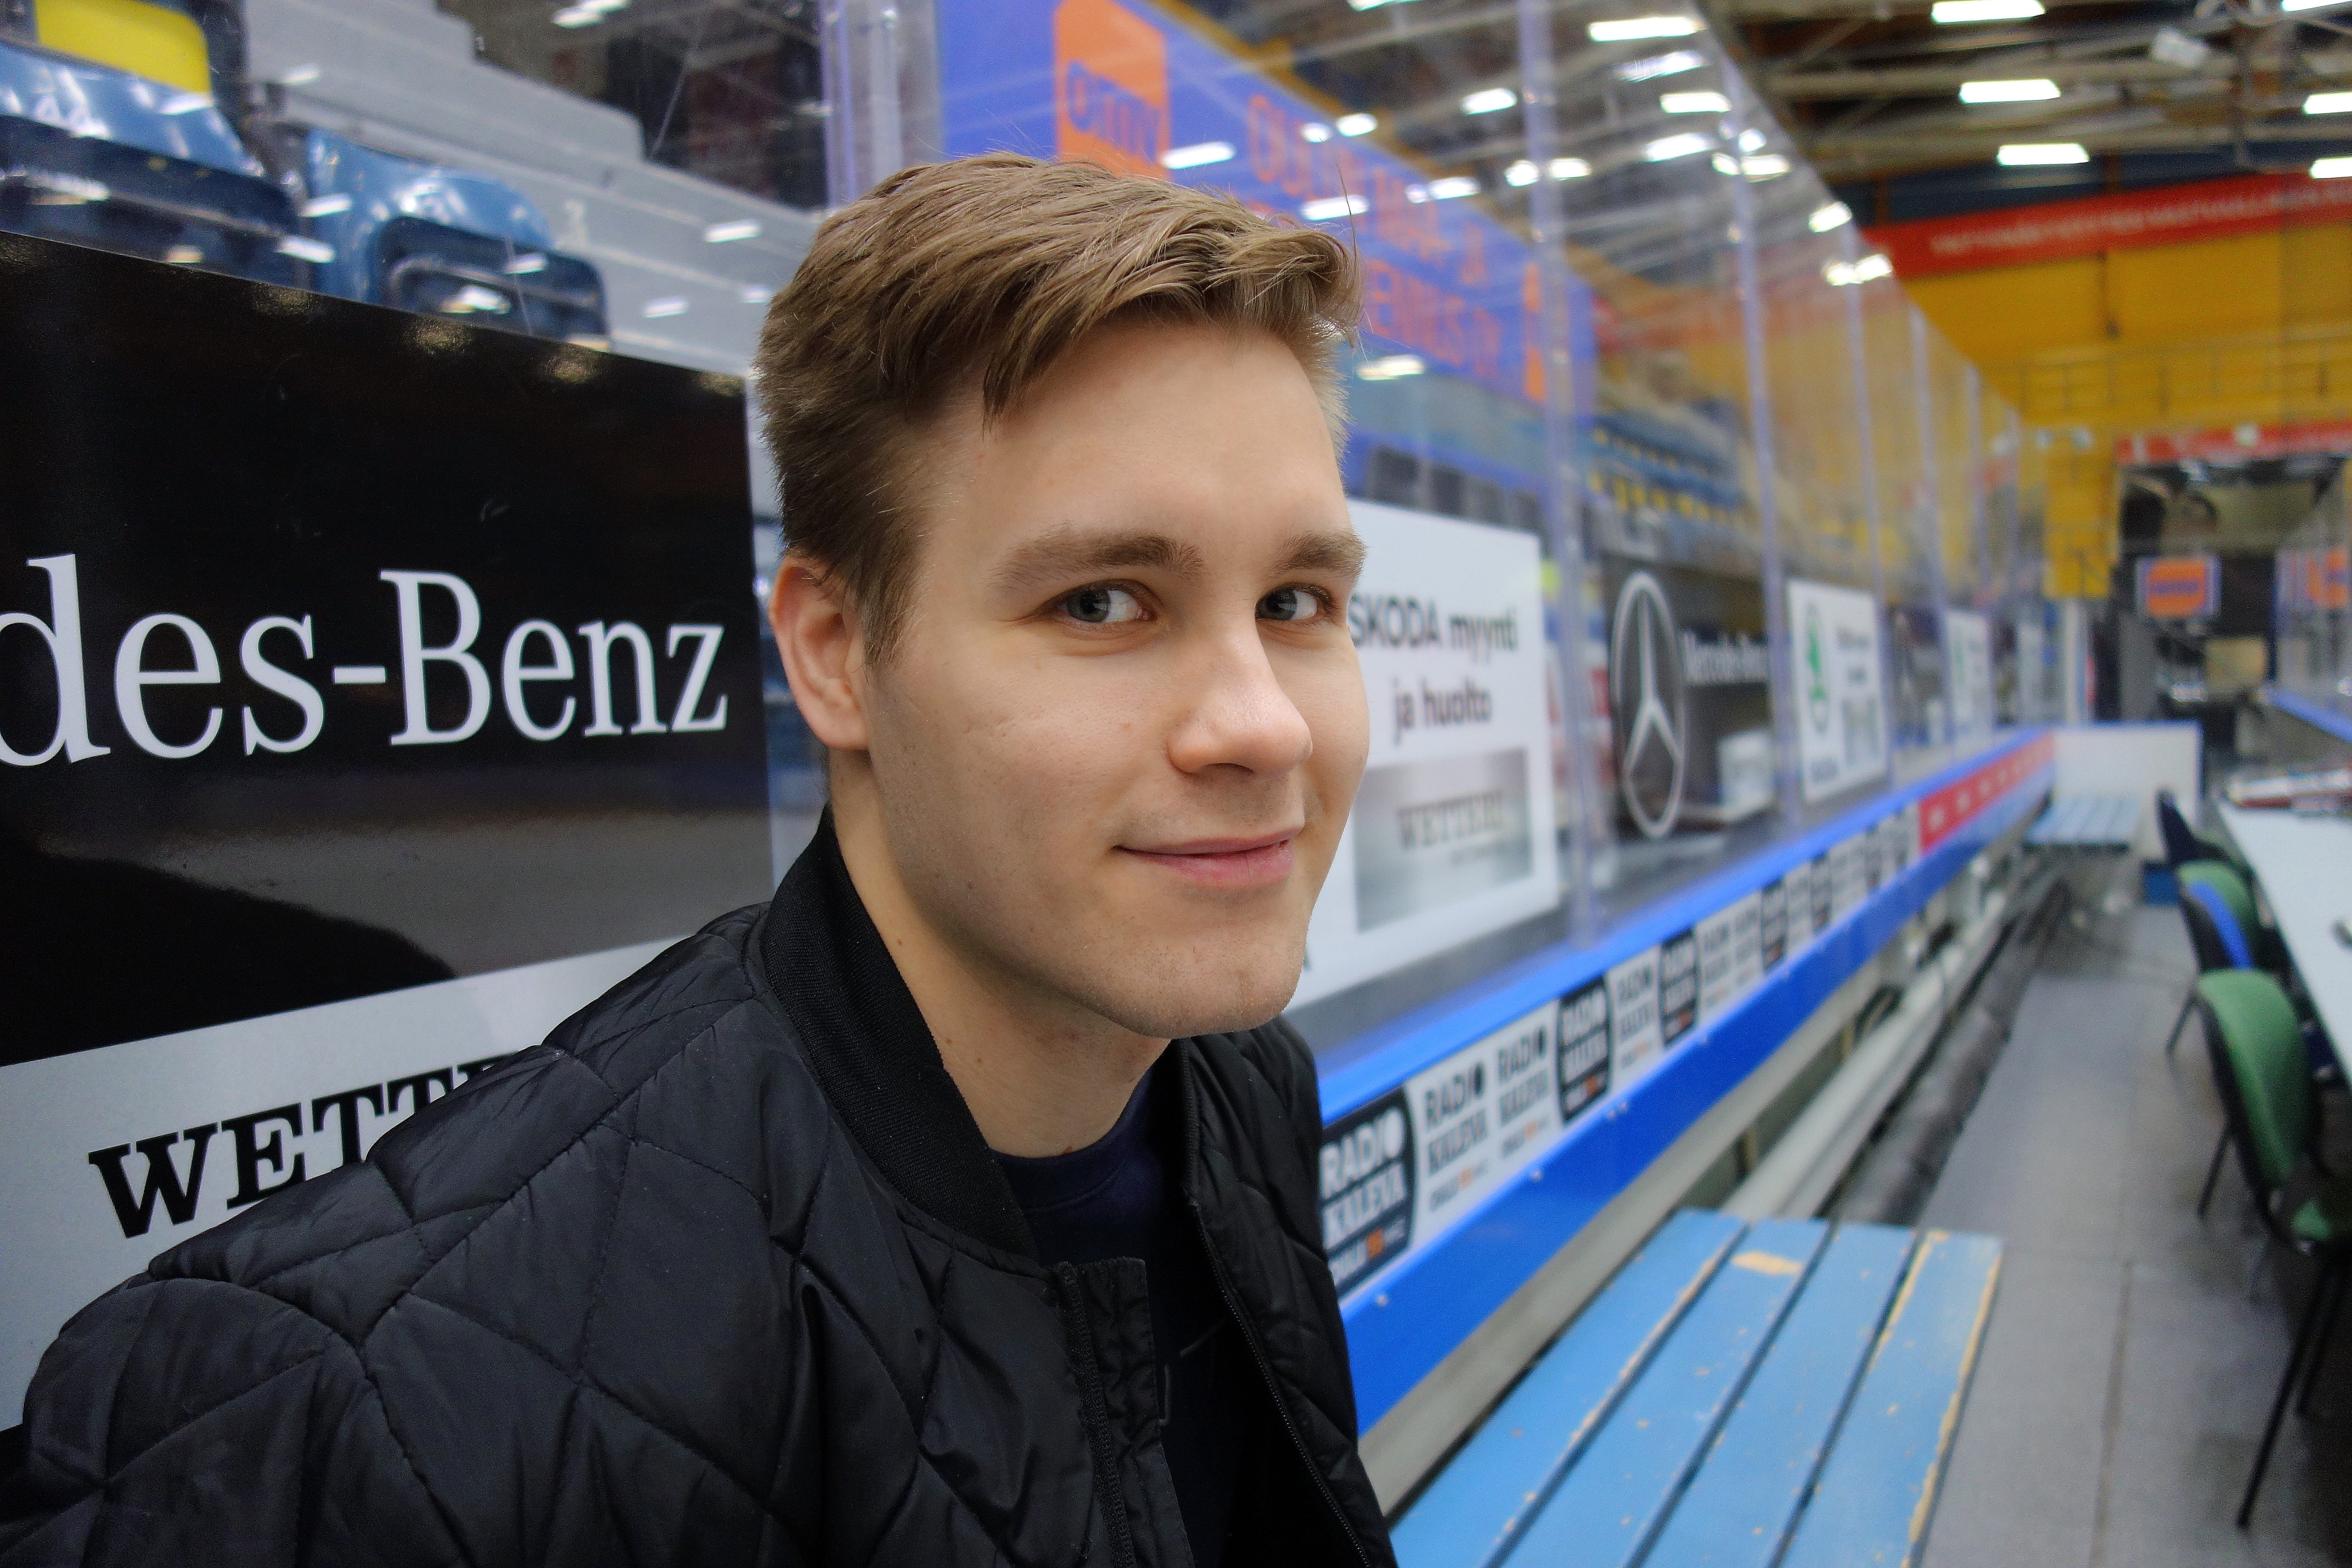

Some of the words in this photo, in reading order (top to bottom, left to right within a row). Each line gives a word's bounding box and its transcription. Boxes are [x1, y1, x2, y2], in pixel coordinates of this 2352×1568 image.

[1393, 677, 1413, 746] ja
[1423, 676, 1491, 727] huolto
[88, 1052, 518, 1238] WETT
